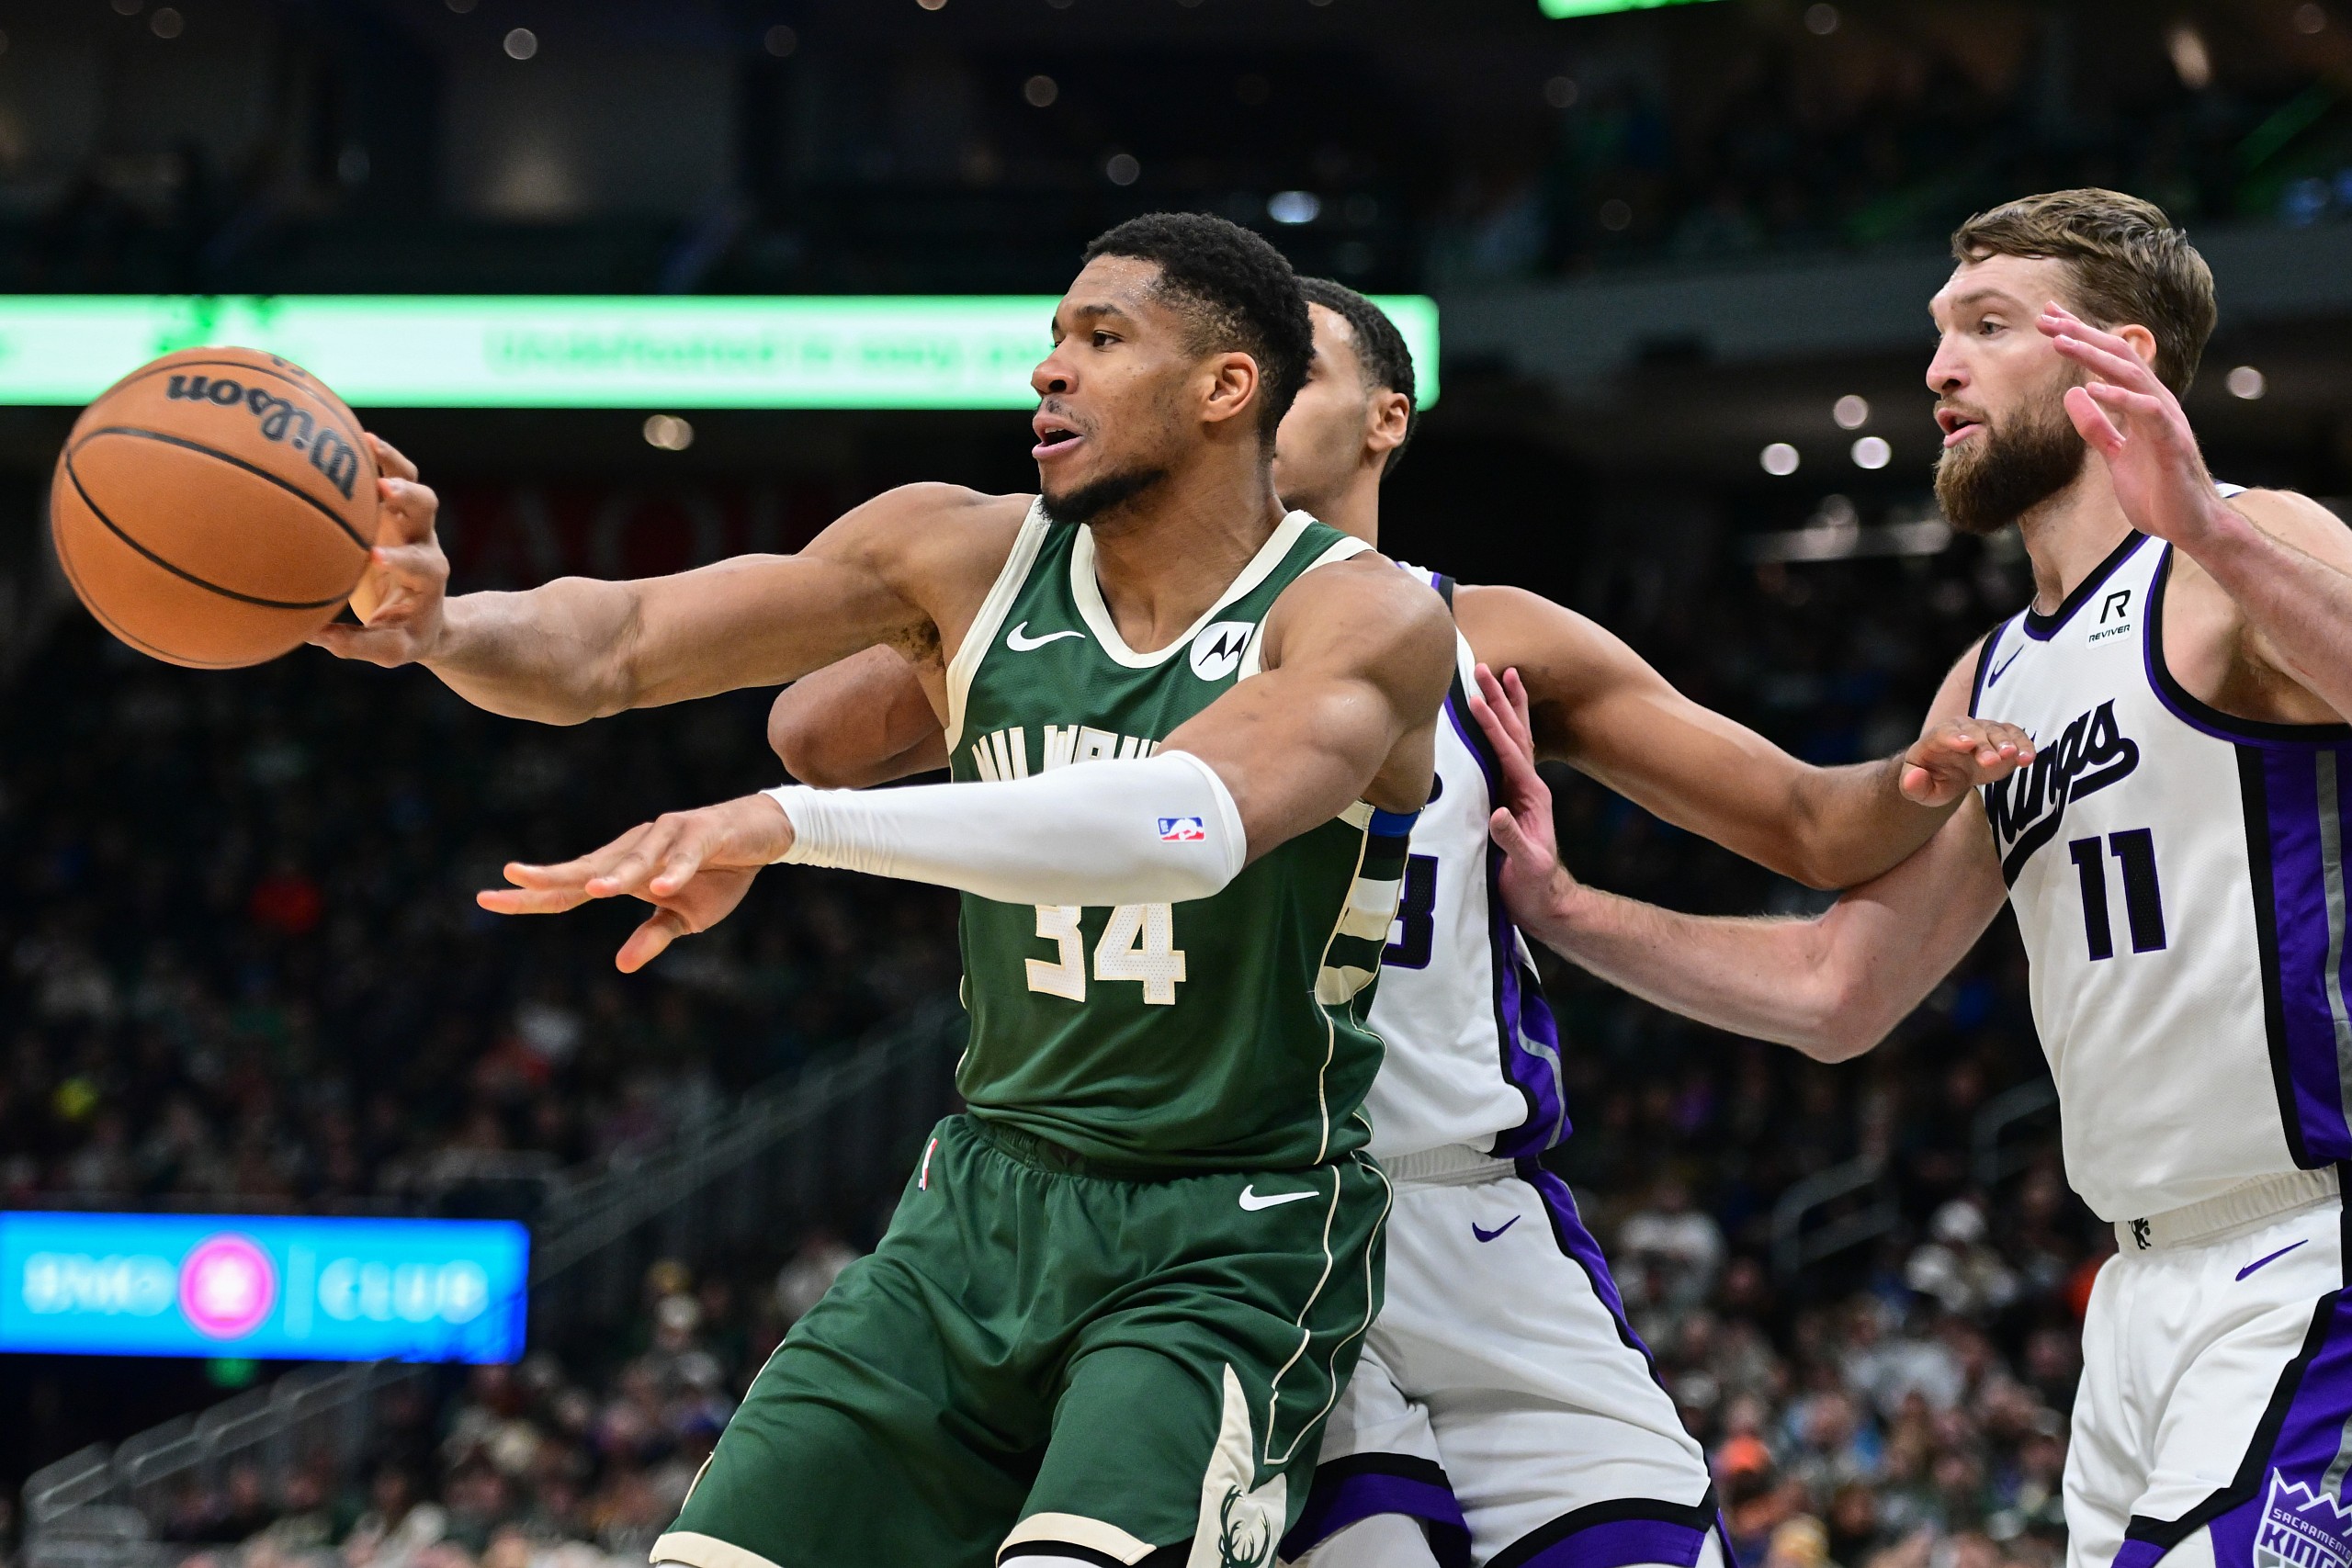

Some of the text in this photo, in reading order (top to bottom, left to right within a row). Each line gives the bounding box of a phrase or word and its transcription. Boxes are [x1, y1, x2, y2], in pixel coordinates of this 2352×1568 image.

[166, 375, 358, 501] Wilson
[2088, 624, 2131, 643] REVIVER
[2068, 828, 2166, 962] 11
[1024, 902, 1187, 1005] 34
[2260, 1522, 2352, 1568] KING
[2272, 1507, 2352, 1560] SACRAMENTO
